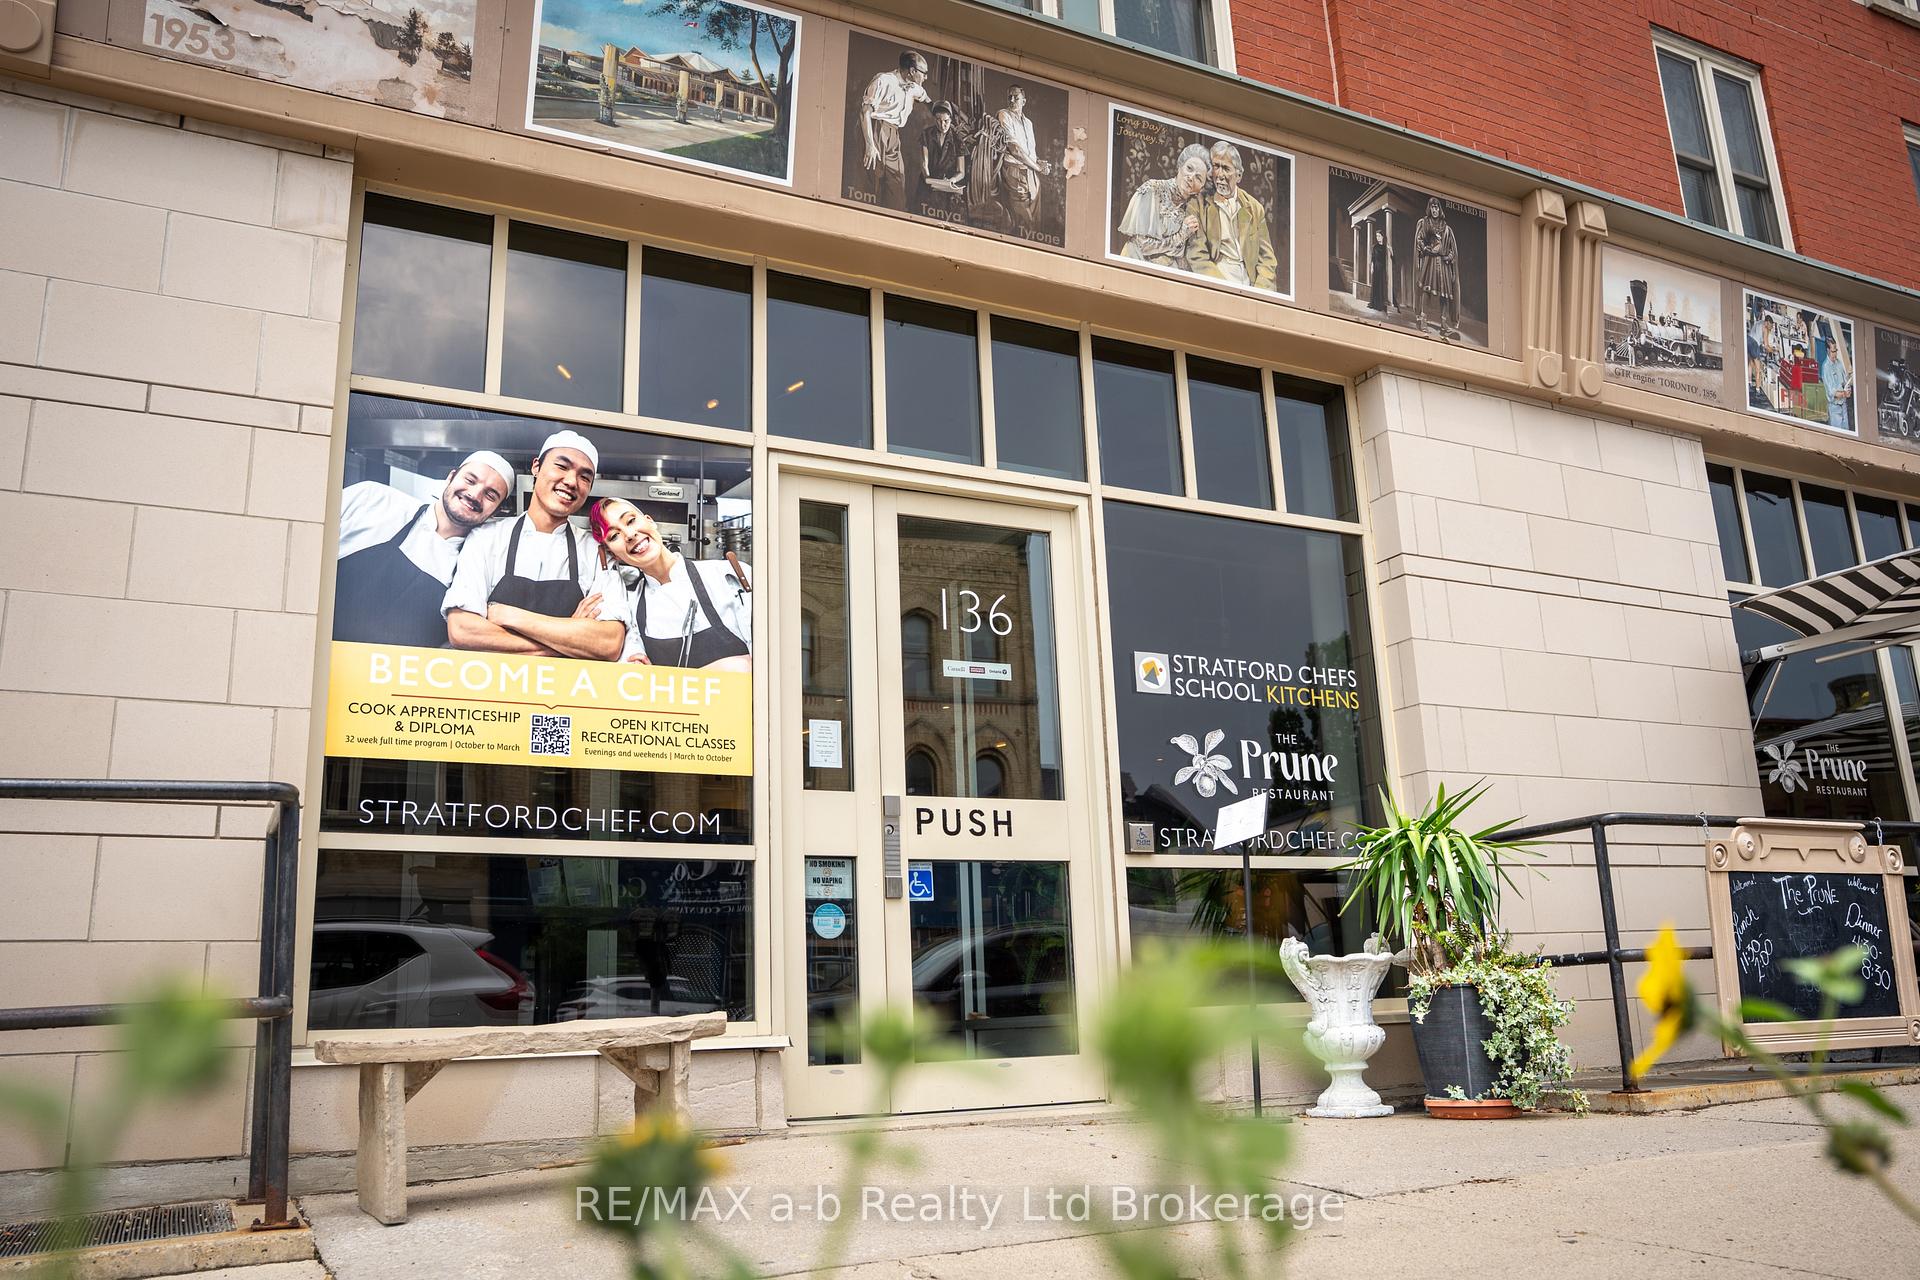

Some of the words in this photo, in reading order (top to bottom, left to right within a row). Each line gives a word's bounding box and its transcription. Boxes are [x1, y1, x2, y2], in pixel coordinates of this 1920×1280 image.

[150, 13, 236, 61] 1953
[1116, 113, 1141, 129] Long
[848, 186, 877, 204] Tom
[920, 203, 962, 223] Tanya
[1445, 200, 1478, 216] RICHARD
[1018, 225, 1061, 246] Tyrone
[1614, 367, 1631, 379] GTR
[1632, 373, 1656, 385] engine
[1703, 389, 1717, 400] 1856
[941, 588, 1013, 636] 136
[369, 653, 557, 697] BECOME
[571, 669, 598, 699] A
[618, 671, 721, 707] CHEF
[1173, 654, 1293, 683] STRATFORD
[1298, 667, 1357, 688] CHEFS
[1175, 678, 1262, 703] SCHOOL
[1266, 685, 1360, 710] KITCHENS
[348, 702, 396, 716] COOK
[400, 705, 521, 723] APPRENTICESHIP
[394, 720, 404, 732] &
[409, 721, 475, 736] DIPLOMA
[610, 718, 647, 731] OPEN
[651, 720, 709, 735] KITCHEN
[345, 735, 355, 743] 32
[357, 736, 378, 745] week
[379, 736, 393, 746] full
[395, 737, 412, 746] time
[415, 739, 448, 750] program
[455, 741, 485, 750] October
[487, 742, 495, 751] to
[496, 743, 520, 752] March
[581, 731, 681, 748] RECREATIONAL
[685, 737, 736, 750] CLASSES
[1275, 733, 1298, 745] THE
[1825, 743, 1840, 753] THE
[584, 748, 616, 758] Evenings
[618, 750, 632, 758] and
[633, 751, 668, 760] weekends
[674, 752, 696, 761] March
[697, 753, 704, 761] to
[705, 754, 733, 763] October
[1240, 739, 1339, 783] Prune
[1805, 748, 1869, 783] Prune
[1816, 786, 1868, 798] RESTAURANT
[359, 799, 721, 836] STRATFORDCHEF.COM
[916, 807, 1013, 838] PUSH
[821, 877, 843, 885] VAPING
[1772, 875, 1804, 909] The
[1733, 905, 1759, 950] Lunch
[1844, 902, 1883, 939] Dinner
[1862, 957, 1891, 990] 8:30
